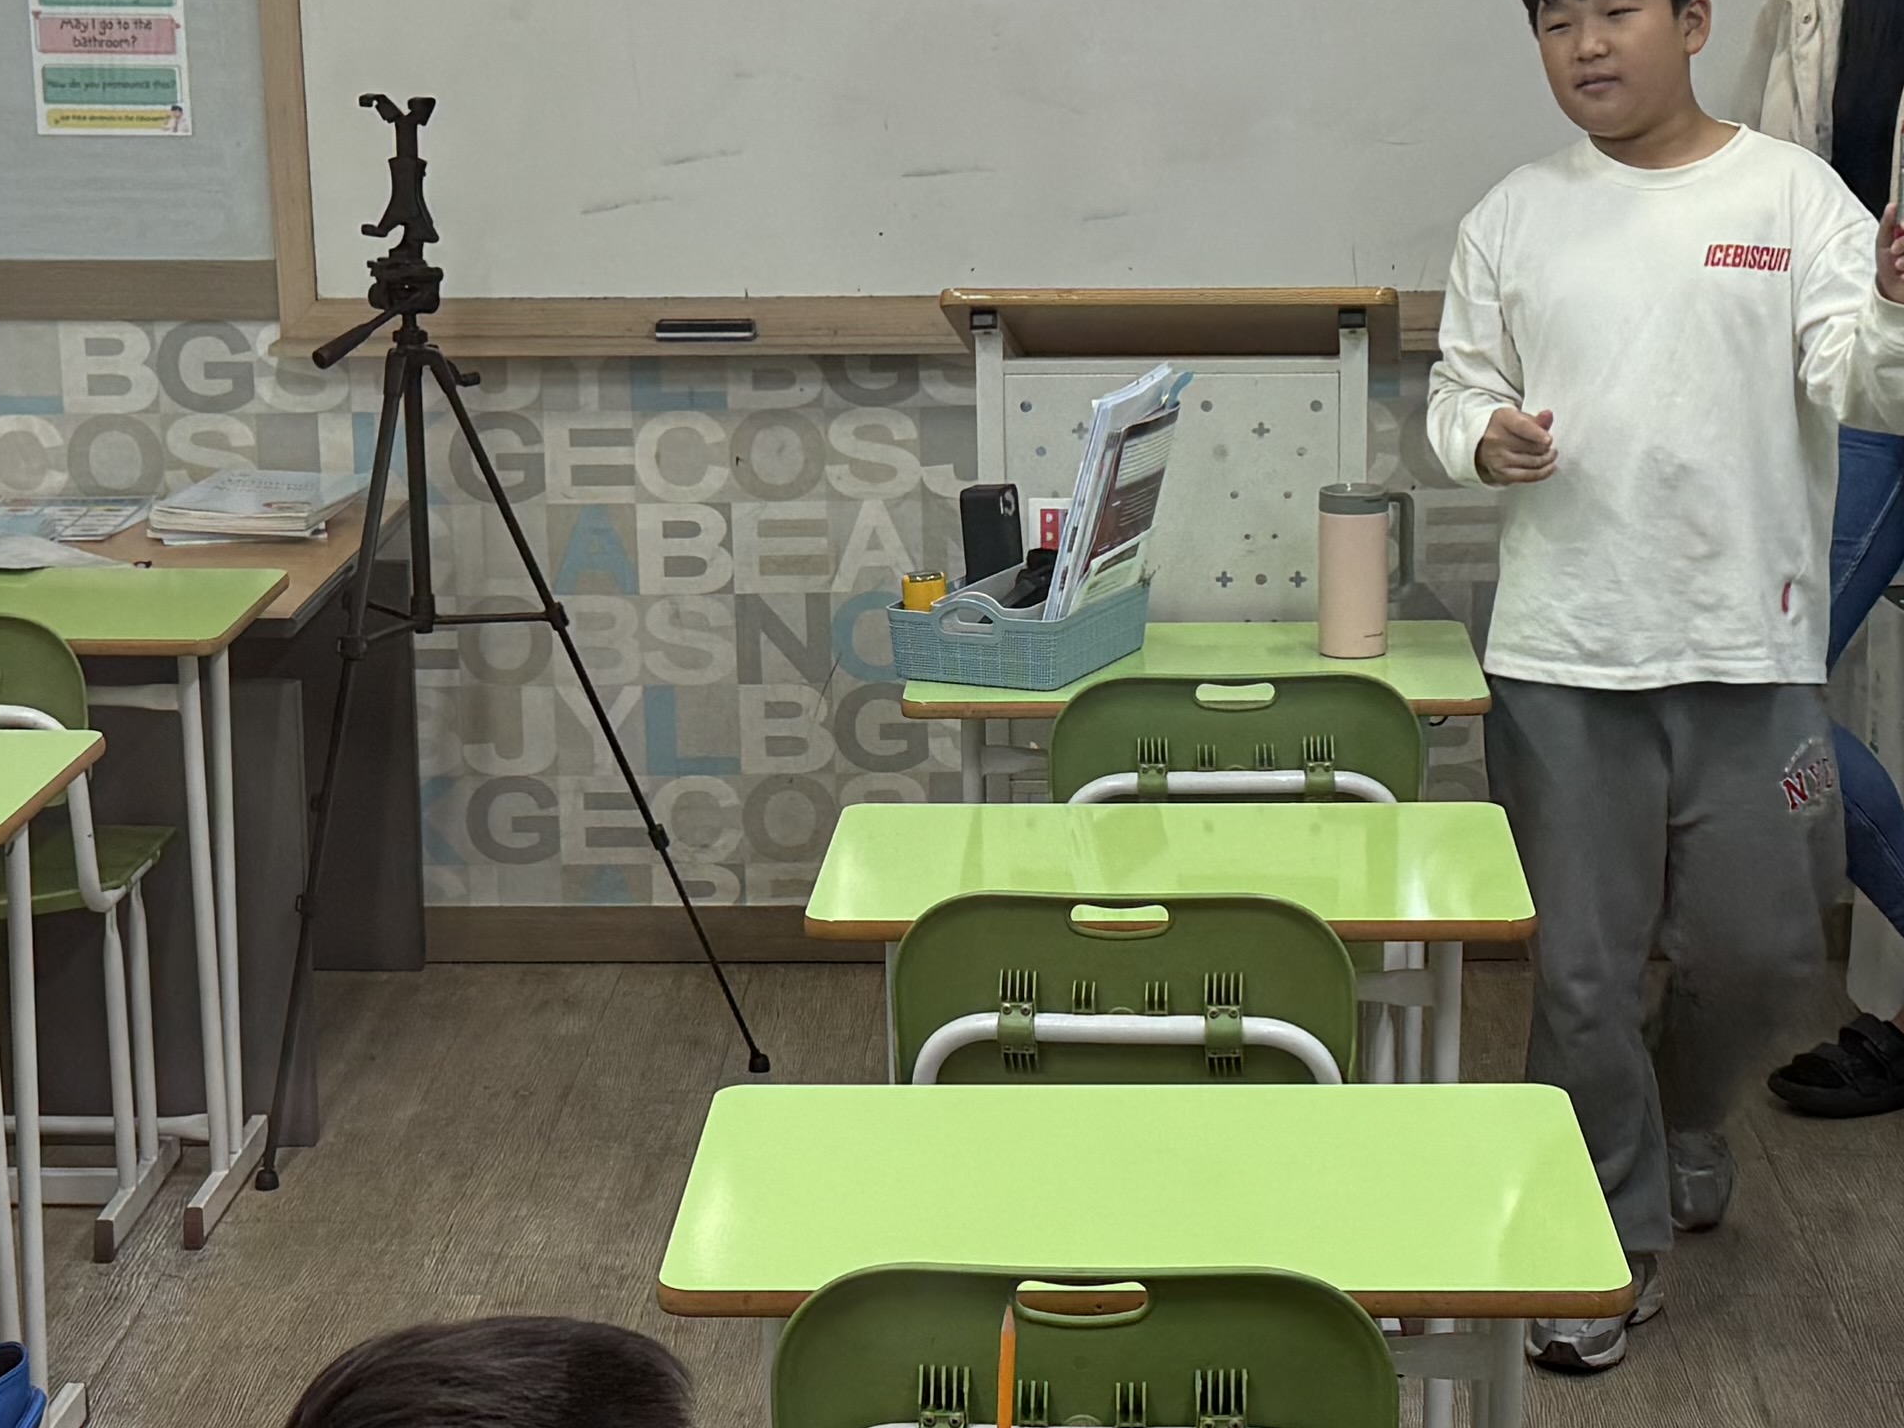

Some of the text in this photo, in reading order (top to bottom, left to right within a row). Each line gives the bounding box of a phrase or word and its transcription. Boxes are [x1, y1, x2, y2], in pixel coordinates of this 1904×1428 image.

[60, 19, 88, 32] May
[100, 20, 113, 35] go
[117, 19, 129, 30] to
[133, 19, 152, 30] the
